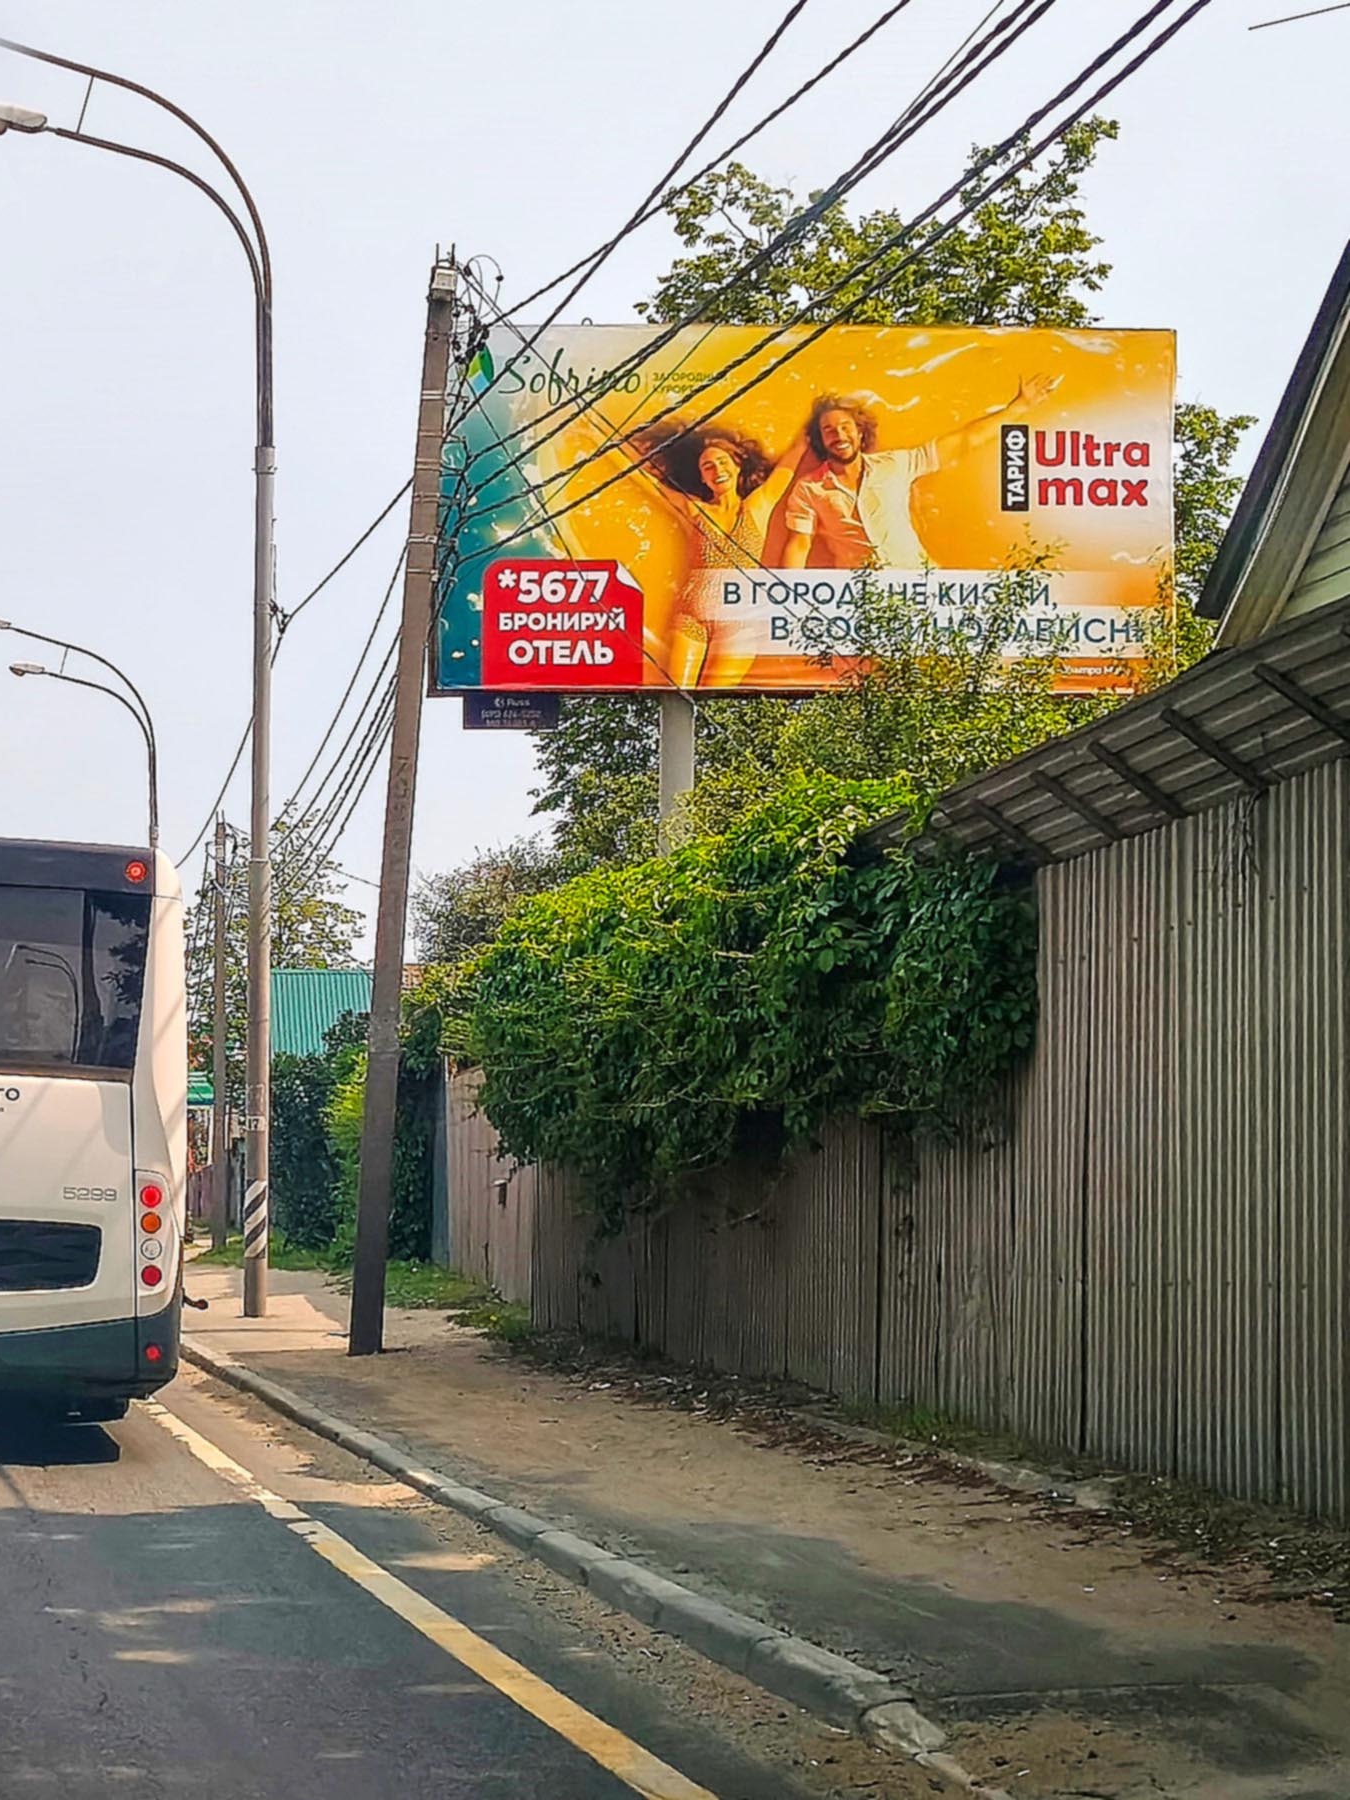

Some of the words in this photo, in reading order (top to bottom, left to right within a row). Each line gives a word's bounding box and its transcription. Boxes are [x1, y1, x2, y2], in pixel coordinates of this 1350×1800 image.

[1035, 430, 1150, 467] Ultra
[1005, 429, 1026, 507] ТАРИФ
[1038, 478, 1148, 507] max
[723, 582, 741, 605] В
[752, 582, 876, 610] ГОРОД
[888, 582, 927, 605] НЕ
[938, 582, 1058, 611] КИСИ,
[498, 607, 626, 631] БРОНИРУЙ
[771, 616, 789, 641] В
[508, 639, 614, 665] ОТЕЛЬ
[63, 1186, 117, 1202] 5299
